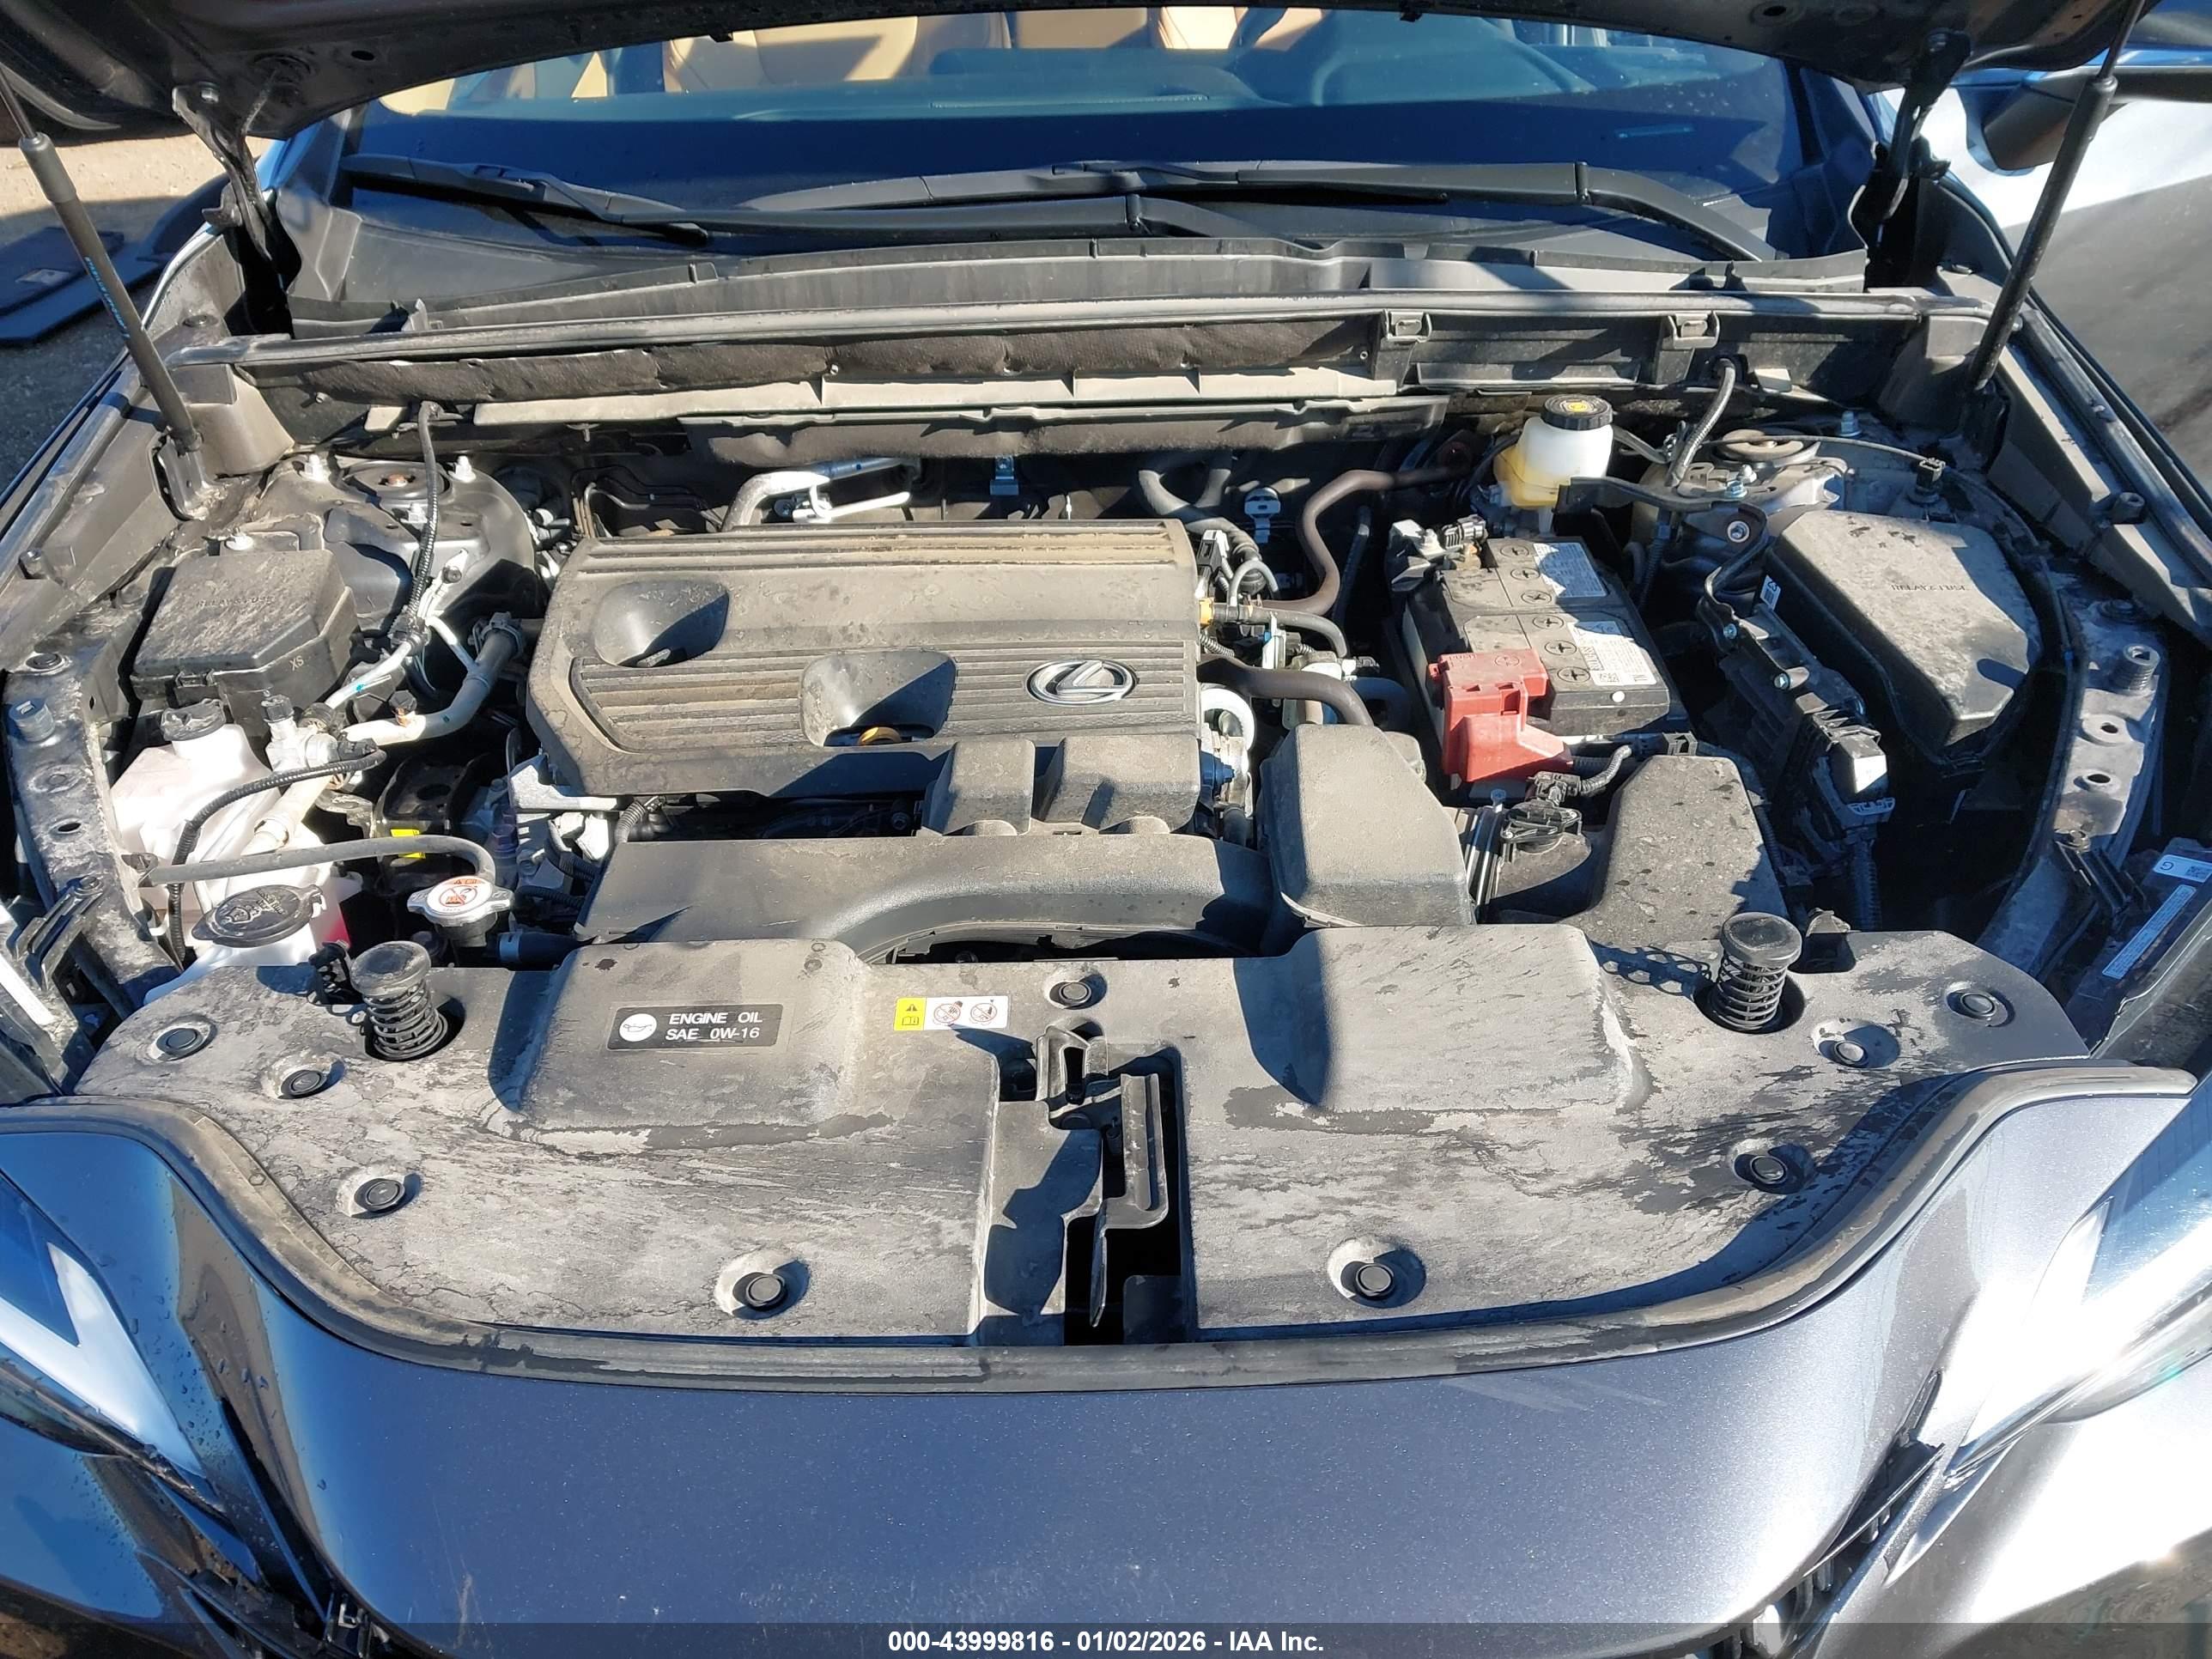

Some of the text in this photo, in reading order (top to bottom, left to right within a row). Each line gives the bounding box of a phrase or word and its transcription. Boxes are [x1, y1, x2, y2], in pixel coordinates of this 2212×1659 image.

[668, 1012, 763, 1025] ENGINE OIL
[665, 1026, 761, 1042] SAE 0W-16
